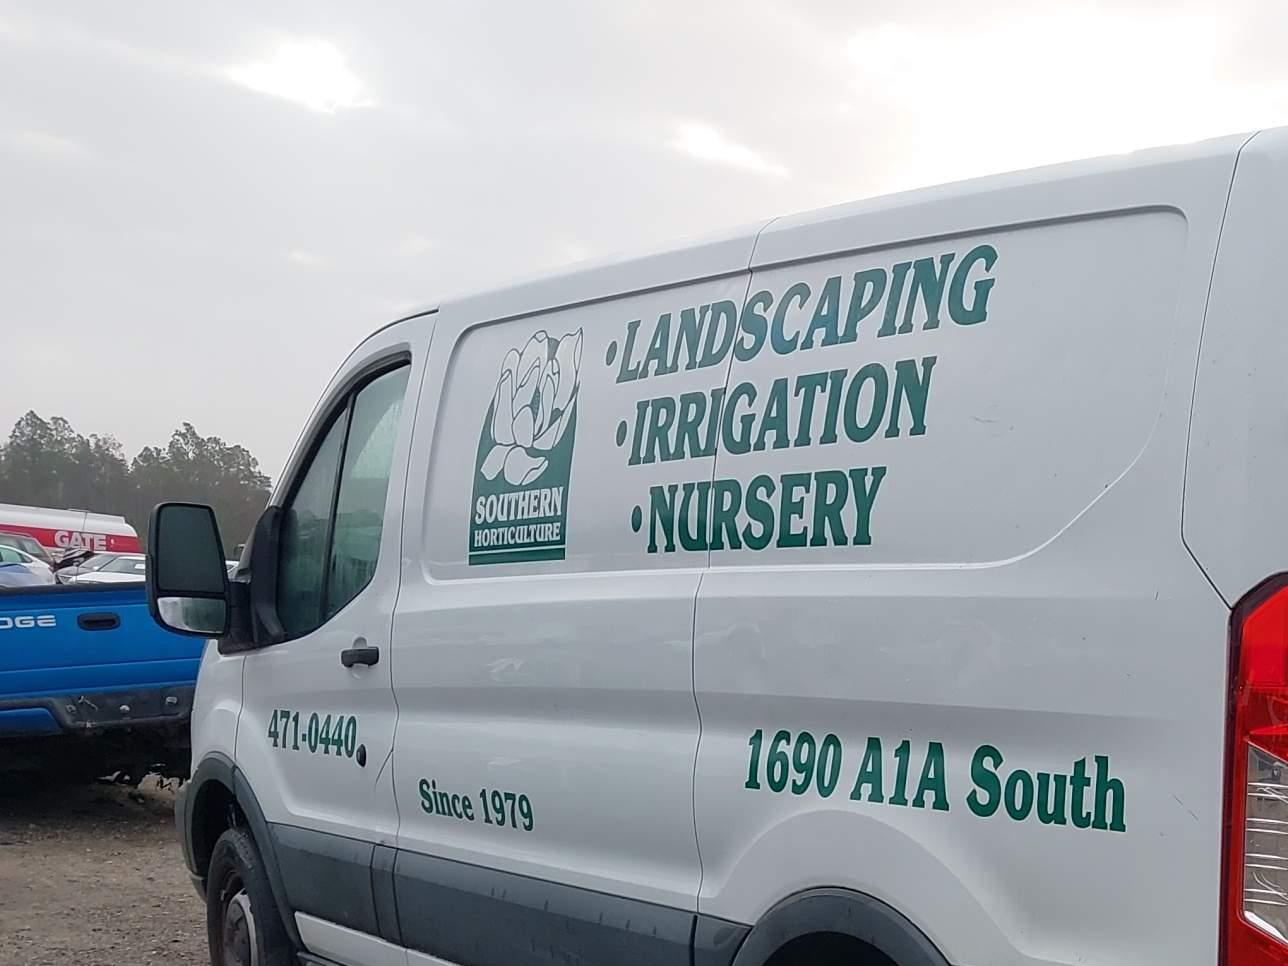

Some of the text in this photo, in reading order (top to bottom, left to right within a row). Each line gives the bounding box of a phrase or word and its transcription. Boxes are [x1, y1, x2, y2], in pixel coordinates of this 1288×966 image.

[615, 244, 999, 384] LANDSCAPING
[627, 356, 937, 466] IRRIGATION
[474, 486, 564, 525] SOUTHERN
[647, 466, 887, 554] NURSERY
[54, 529, 107, 551] GATE
[473, 522, 561, 547] HORTICULTURE
[267, 708, 357, 758] 471-0440
[418, 778, 534, 832] Since 1979
[744, 728, 1127, 833] 1690 A1A South
